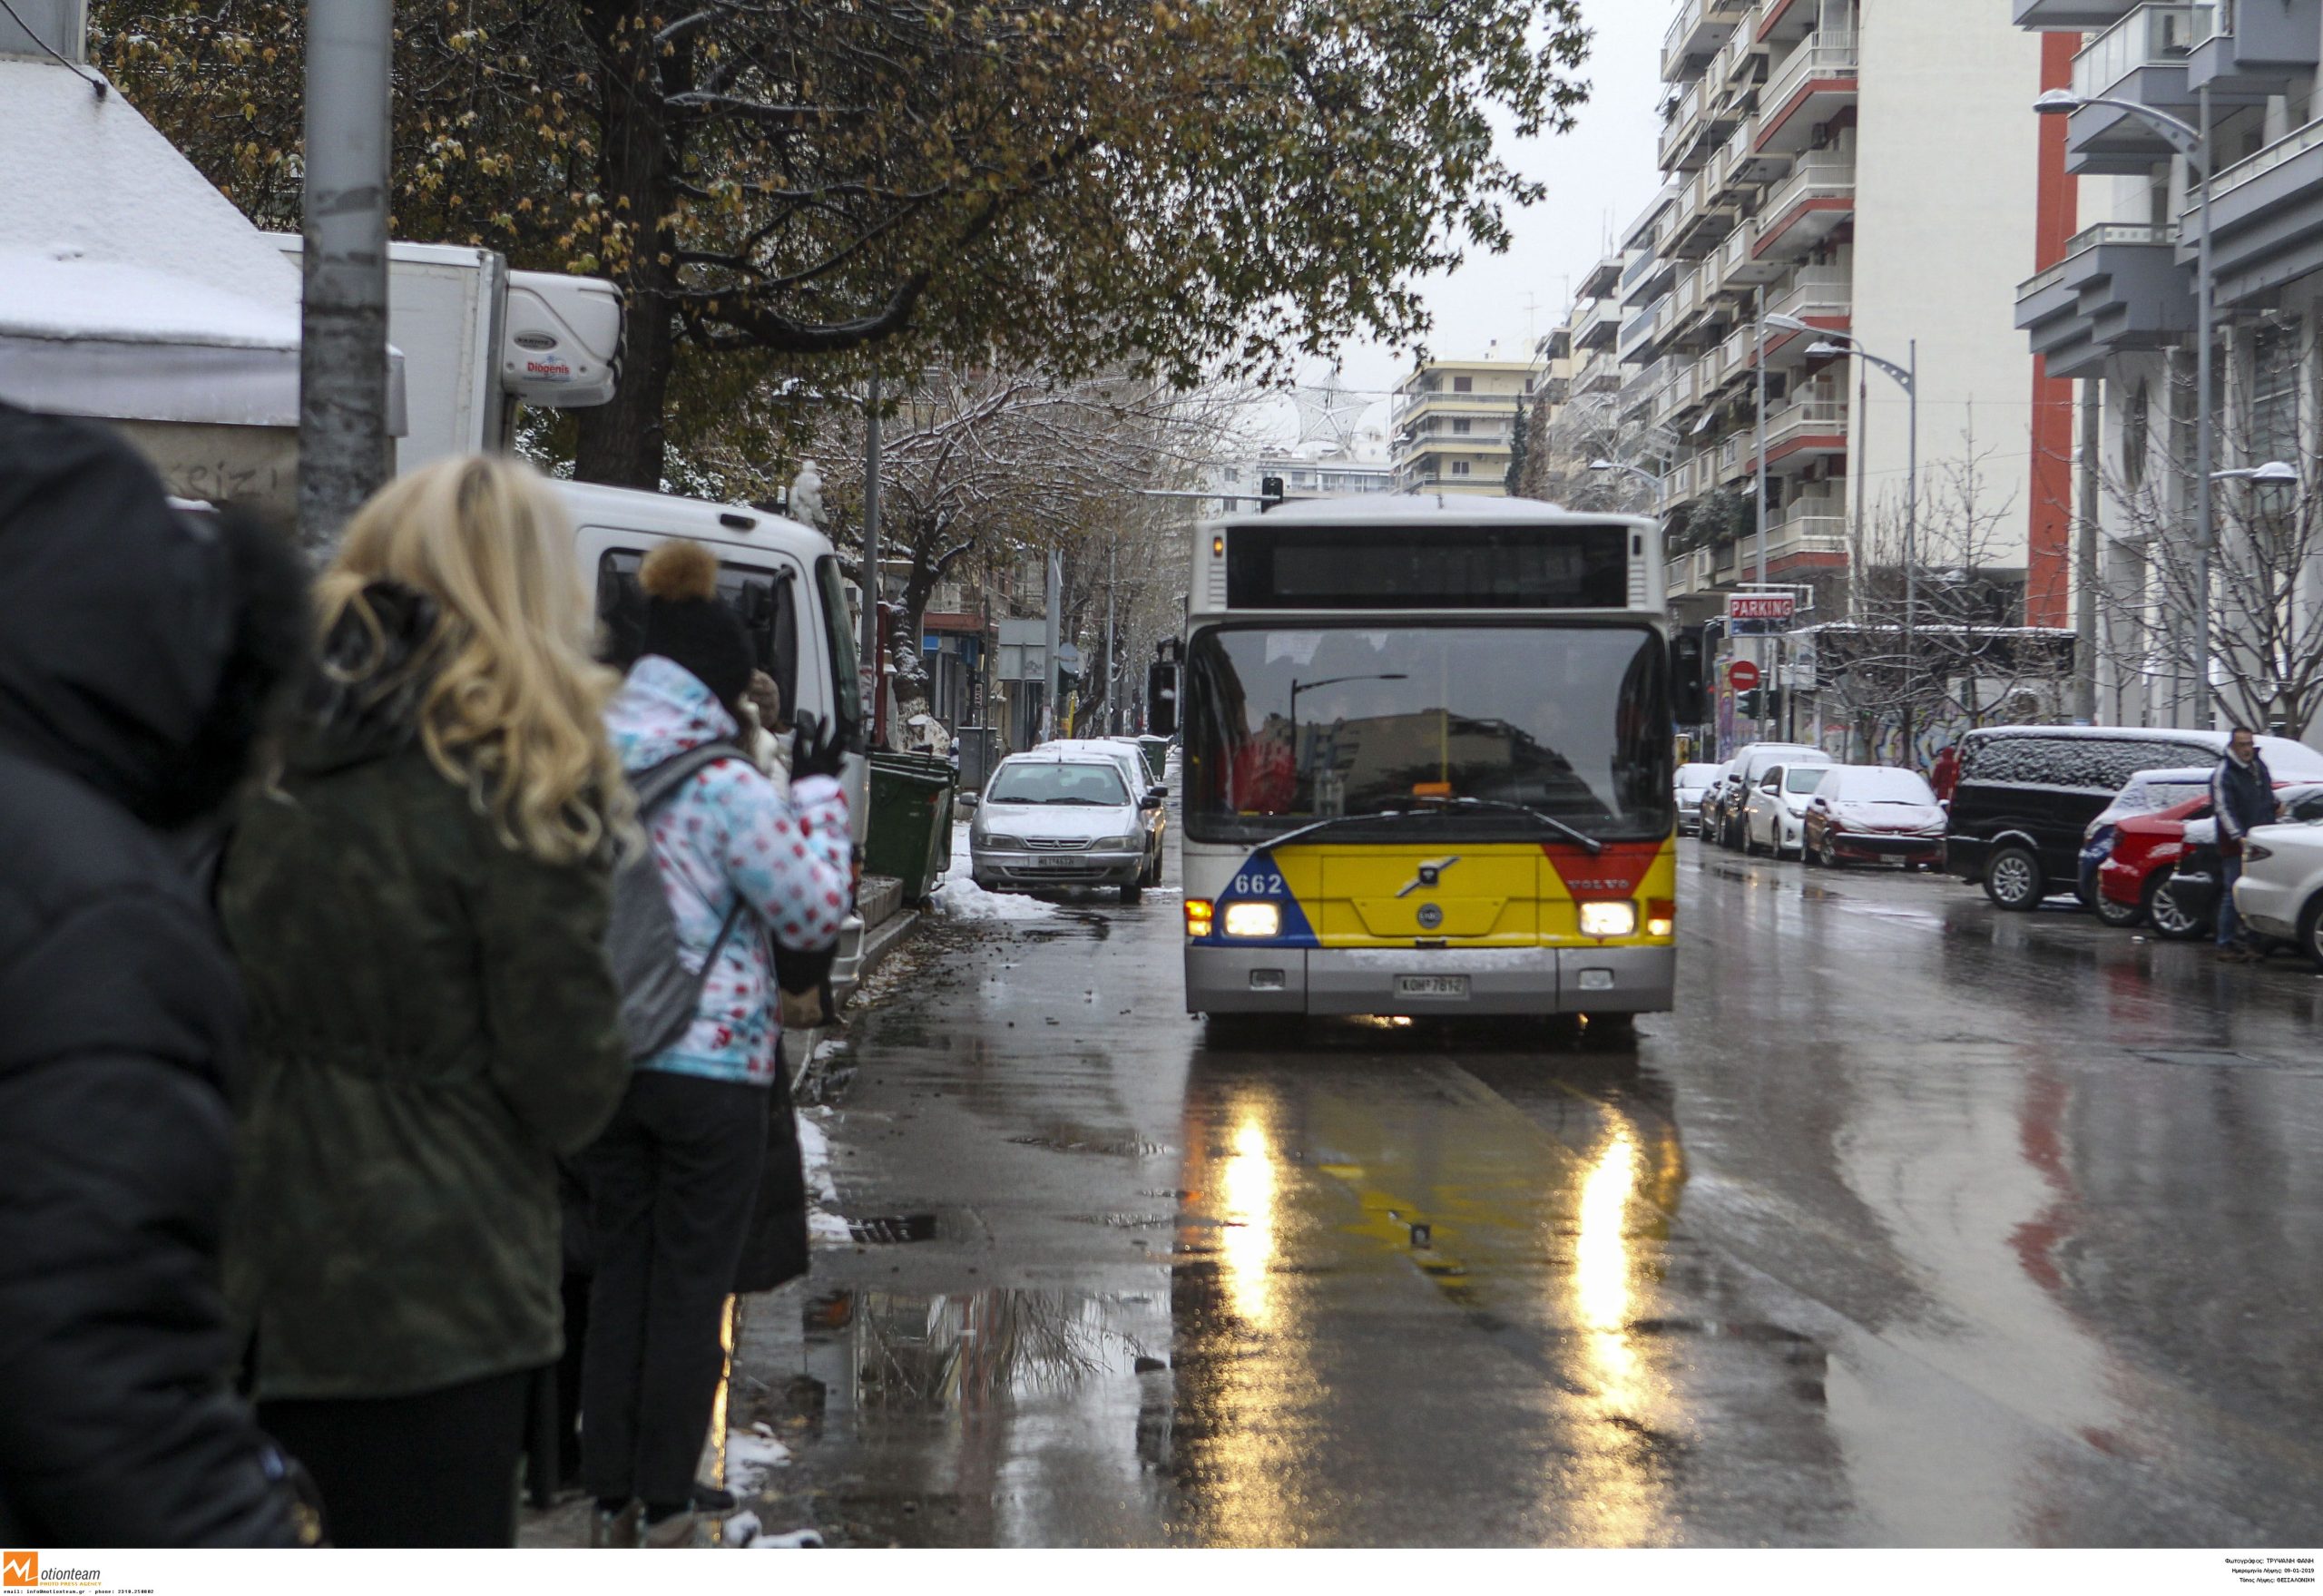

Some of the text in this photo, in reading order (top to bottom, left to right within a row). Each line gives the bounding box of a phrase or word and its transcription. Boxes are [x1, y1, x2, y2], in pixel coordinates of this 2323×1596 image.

[527, 362, 570, 377] Diogenis
[1731, 600, 1792, 617] PARKING
[1235, 874, 1281, 894] 662
[1566, 879, 1630, 890] VOLVO
